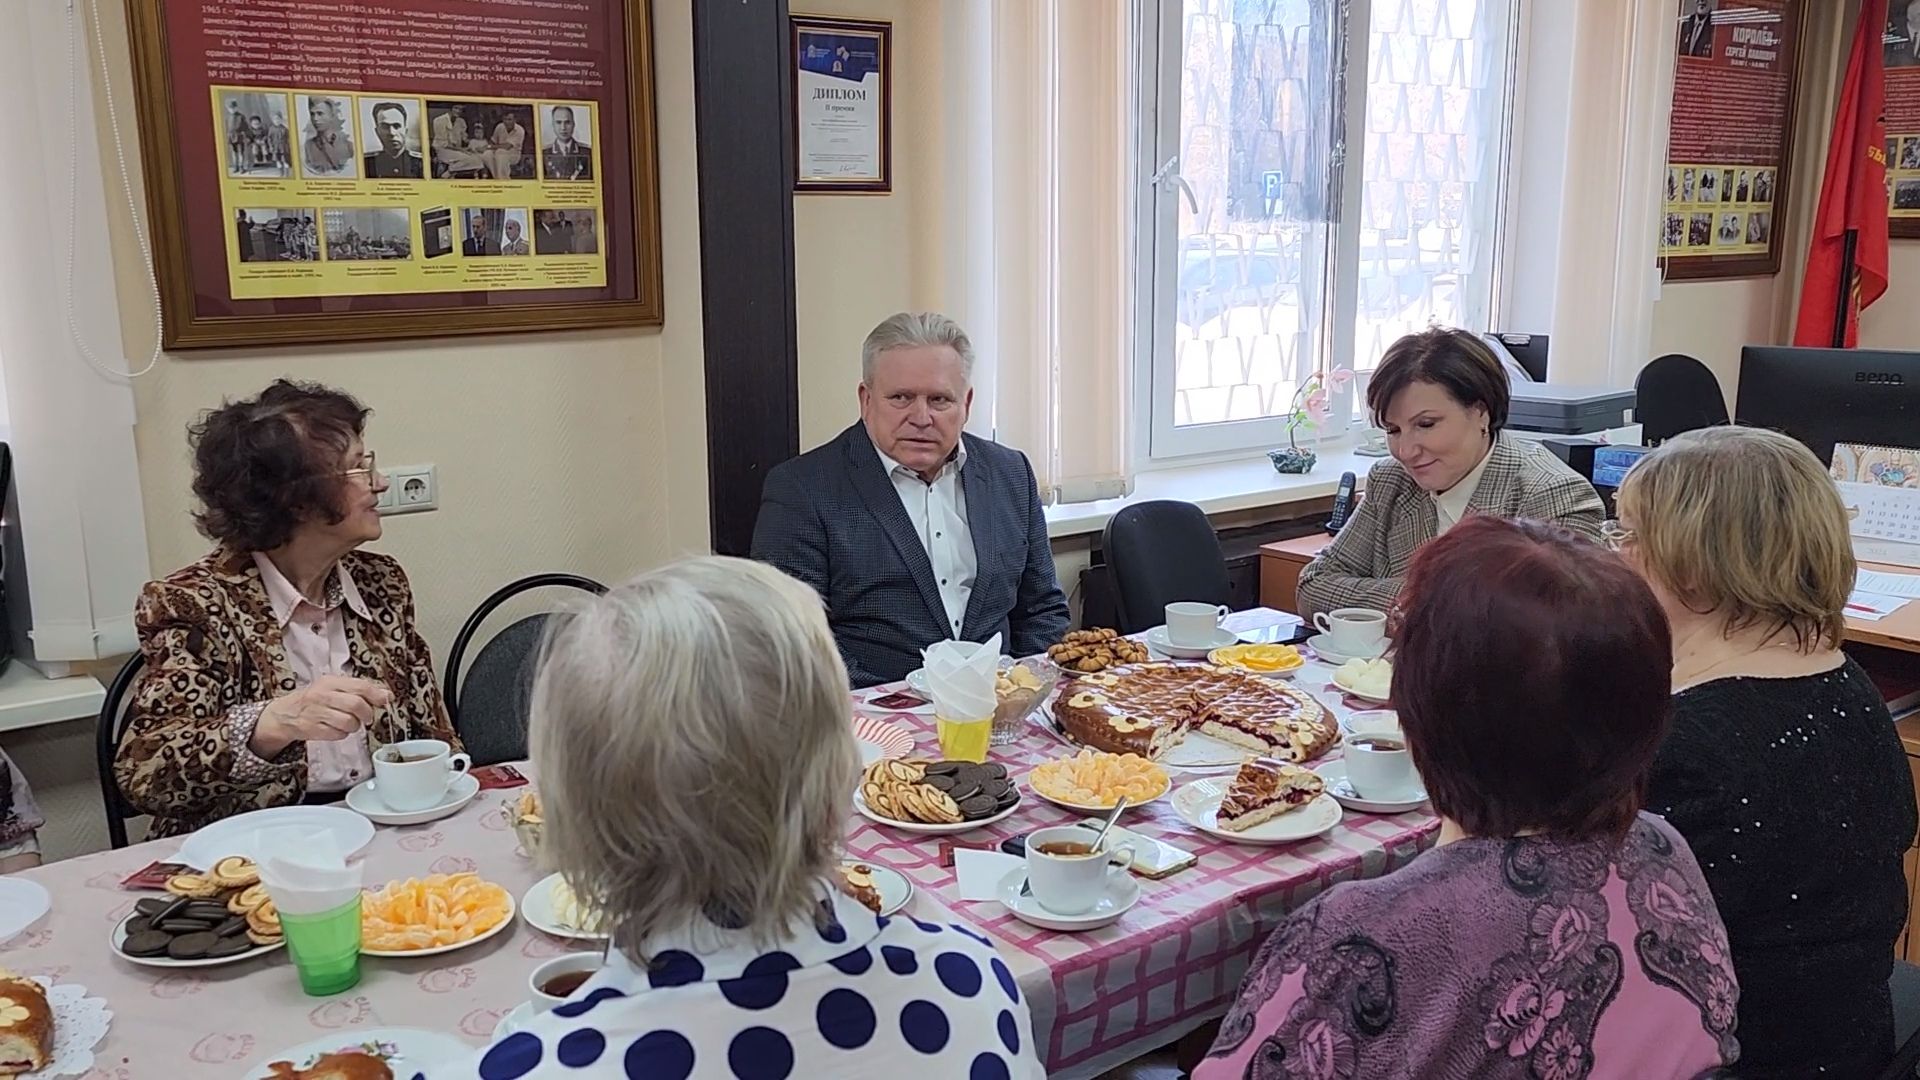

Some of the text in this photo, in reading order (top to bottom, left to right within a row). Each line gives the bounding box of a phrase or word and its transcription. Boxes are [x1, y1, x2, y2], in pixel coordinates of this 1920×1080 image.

[338, 25, 355, 33] 1966
[1732, 26, 1774, 46] КОРОЛЁВ
[1725, 45, 1747, 58] СЕРГЕЙ
[812, 87, 866, 101] ДИПЛОМ
